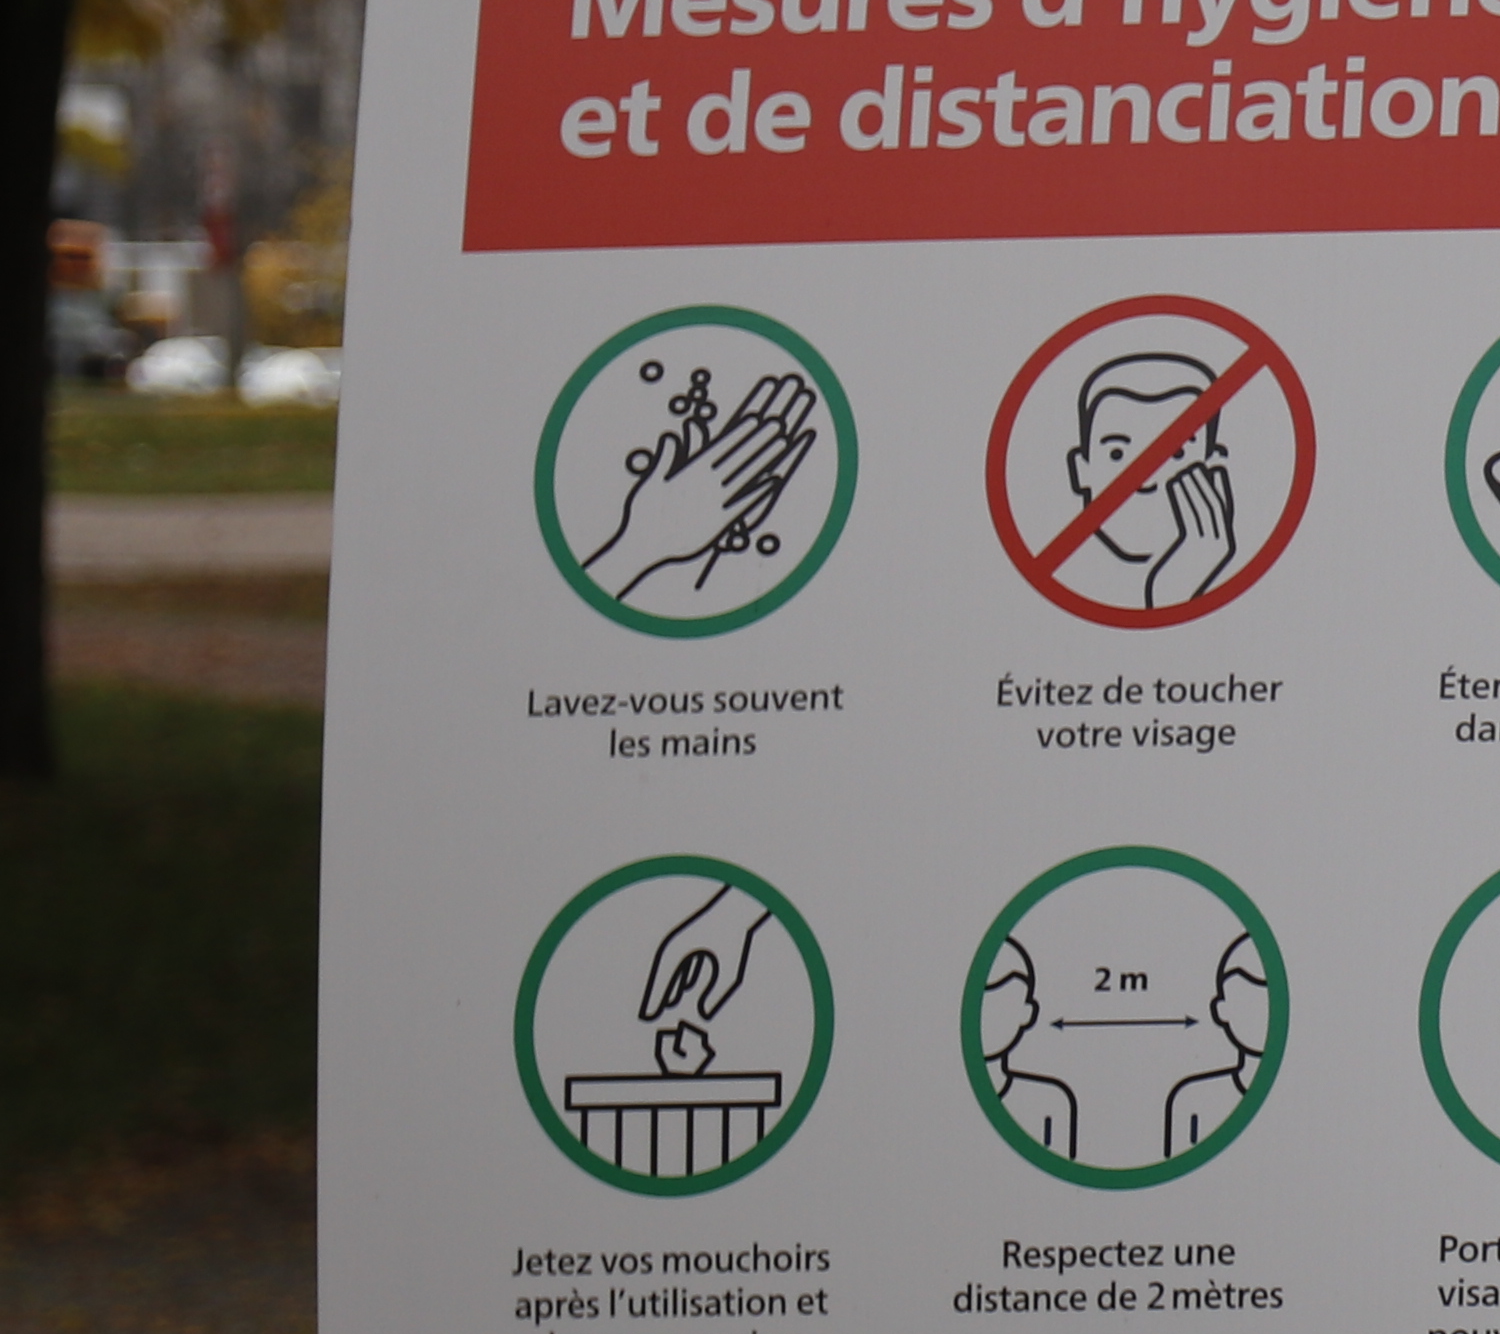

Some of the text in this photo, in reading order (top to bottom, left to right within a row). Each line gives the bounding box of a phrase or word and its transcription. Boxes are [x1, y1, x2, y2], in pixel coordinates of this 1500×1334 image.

[559, 55, 1500, 159] et de distanciation
[527, 684, 844, 718] Lavez-vous souvent
[996, 671, 1284, 708] Évitez de toucher
[609, 726, 757, 759] les mains
[1036, 717, 1237, 755] votre visage
[1093, 966, 1149, 993] 2 m
[512, 1241, 831, 1277] Jetez vos mouchoirs
[1002, 1239, 1237, 1277] Respectez une
